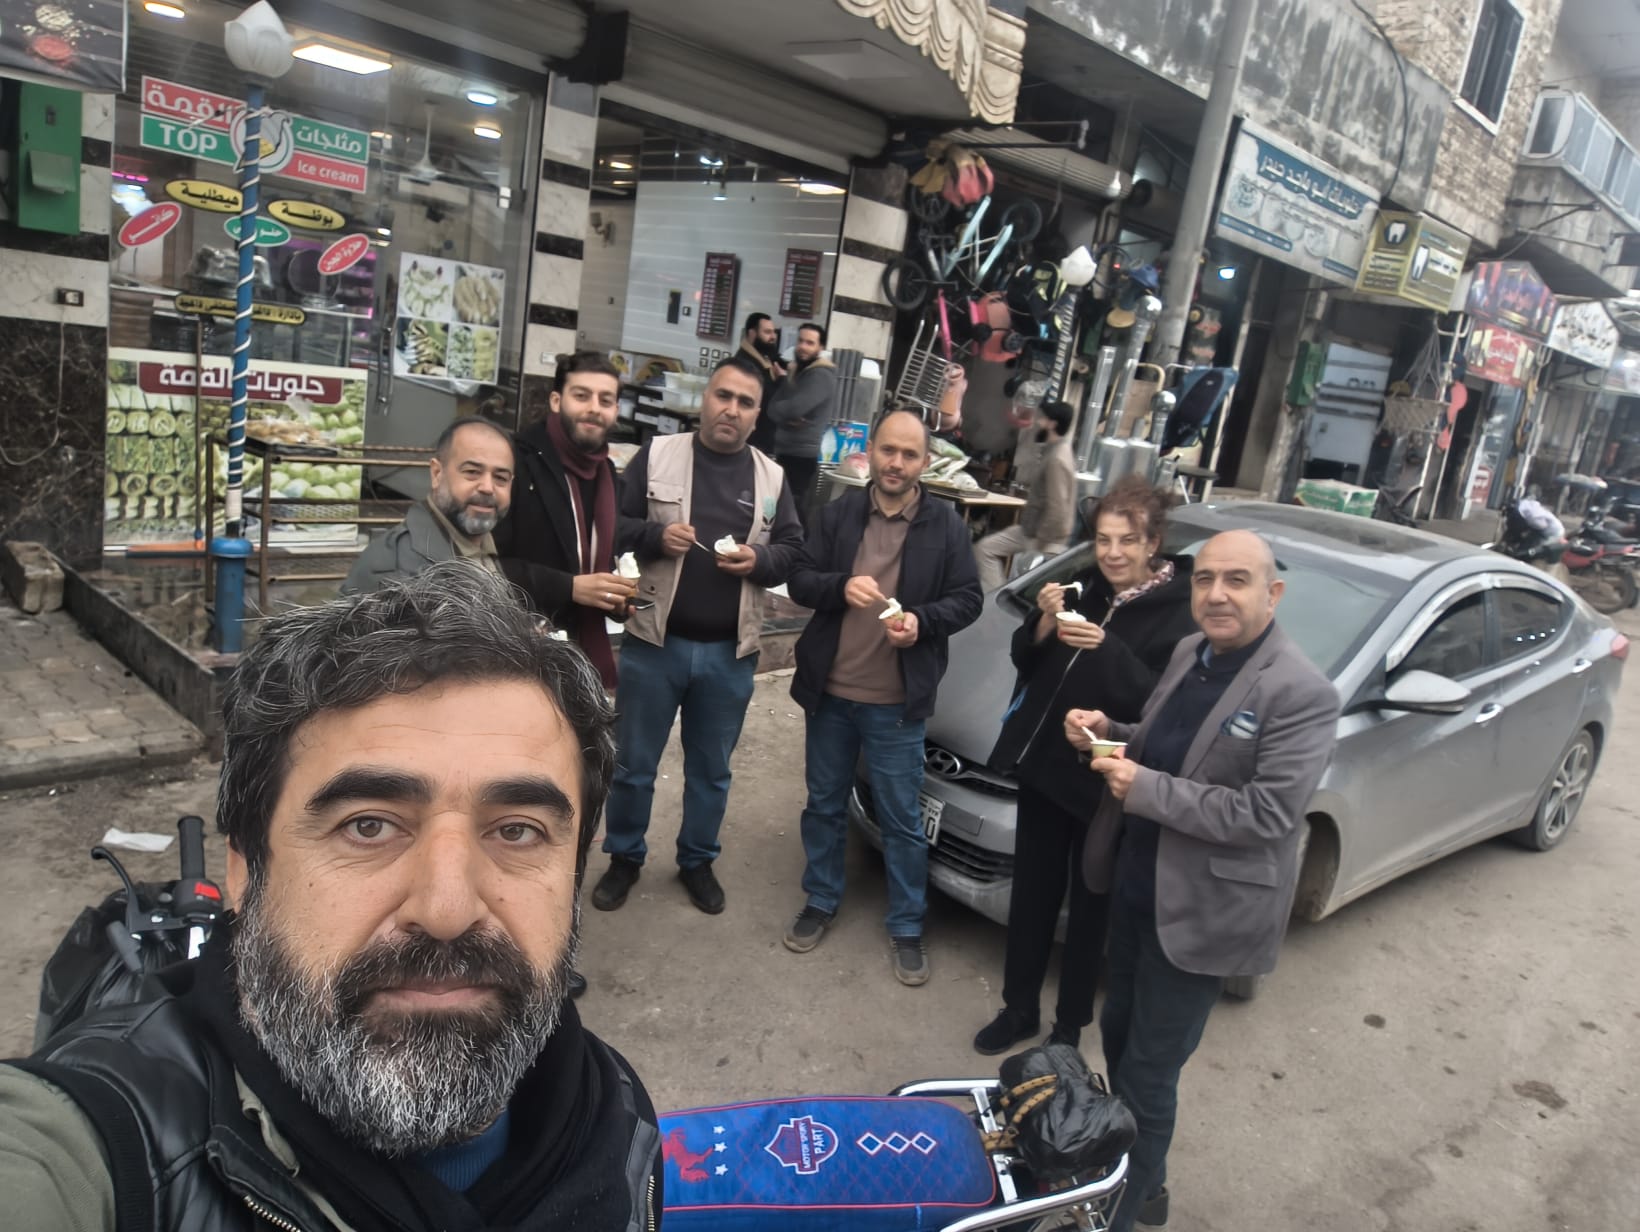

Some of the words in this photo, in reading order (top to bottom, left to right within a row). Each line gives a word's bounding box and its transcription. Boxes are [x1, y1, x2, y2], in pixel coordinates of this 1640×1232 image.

[147, 84, 233, 124] القمة
[158, 123, 218, 153] TOP
[296, 126, 362, 153] مثلجات
[297, 160, 317, 175] Ice
[319, 167, 359, 184] cream
[1259, 155, 1285, 179] حيدر
[1286, 168, 1312, 191] ماجد
[281, 202, 334, 227] بوظة
[159, 364, 233, 387] القمة
[246, 369, 326, 399] حلويات
[812, 1129, 826, 1154] PART
[801, 1144, 811, 1168] MOTOR
